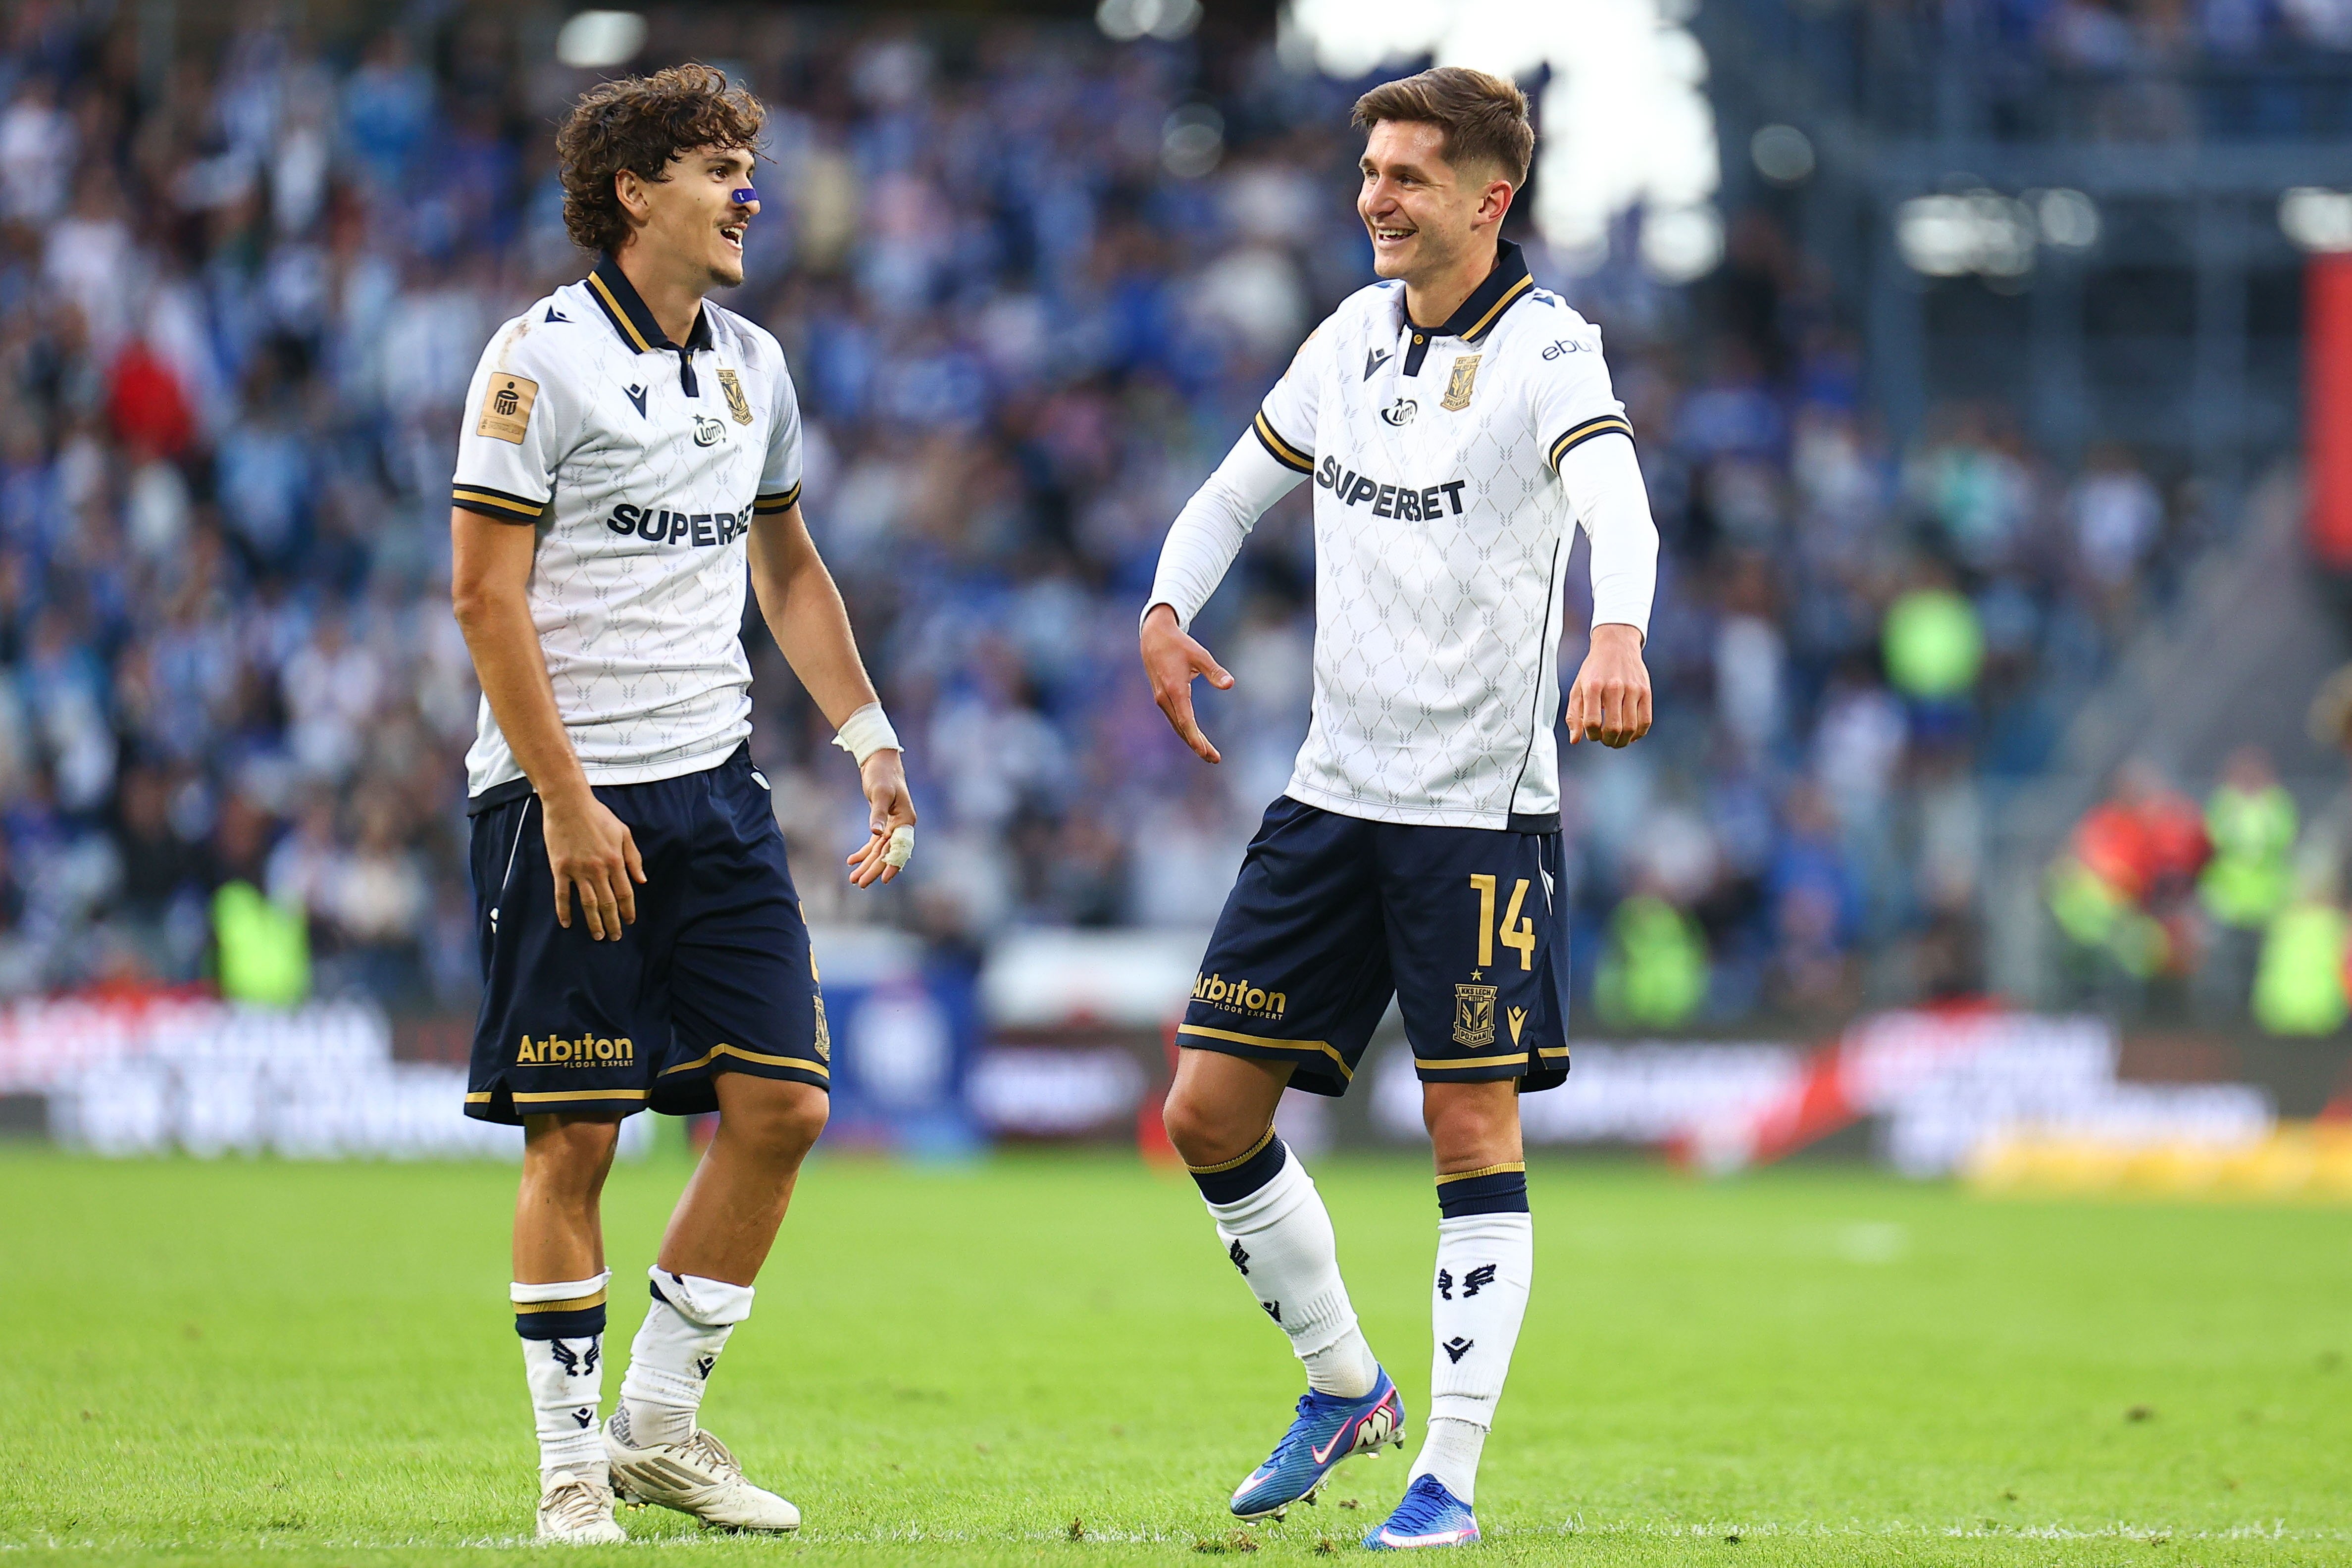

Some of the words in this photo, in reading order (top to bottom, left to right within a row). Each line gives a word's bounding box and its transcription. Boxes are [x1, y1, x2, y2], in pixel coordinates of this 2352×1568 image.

[1392, 405, 1413, 421] LOTTO
[700, 424, 721, 441] LOTTO
[1316, 455, 1465, 521] SUPERBET
[607, 502, 754, 547] SUPERBE
[1470, 873, 1535, 971] 14
[1215, 1003, 1242, 1014] FLOOR
[1247, 1010, 1283, 1021] EXPERT
